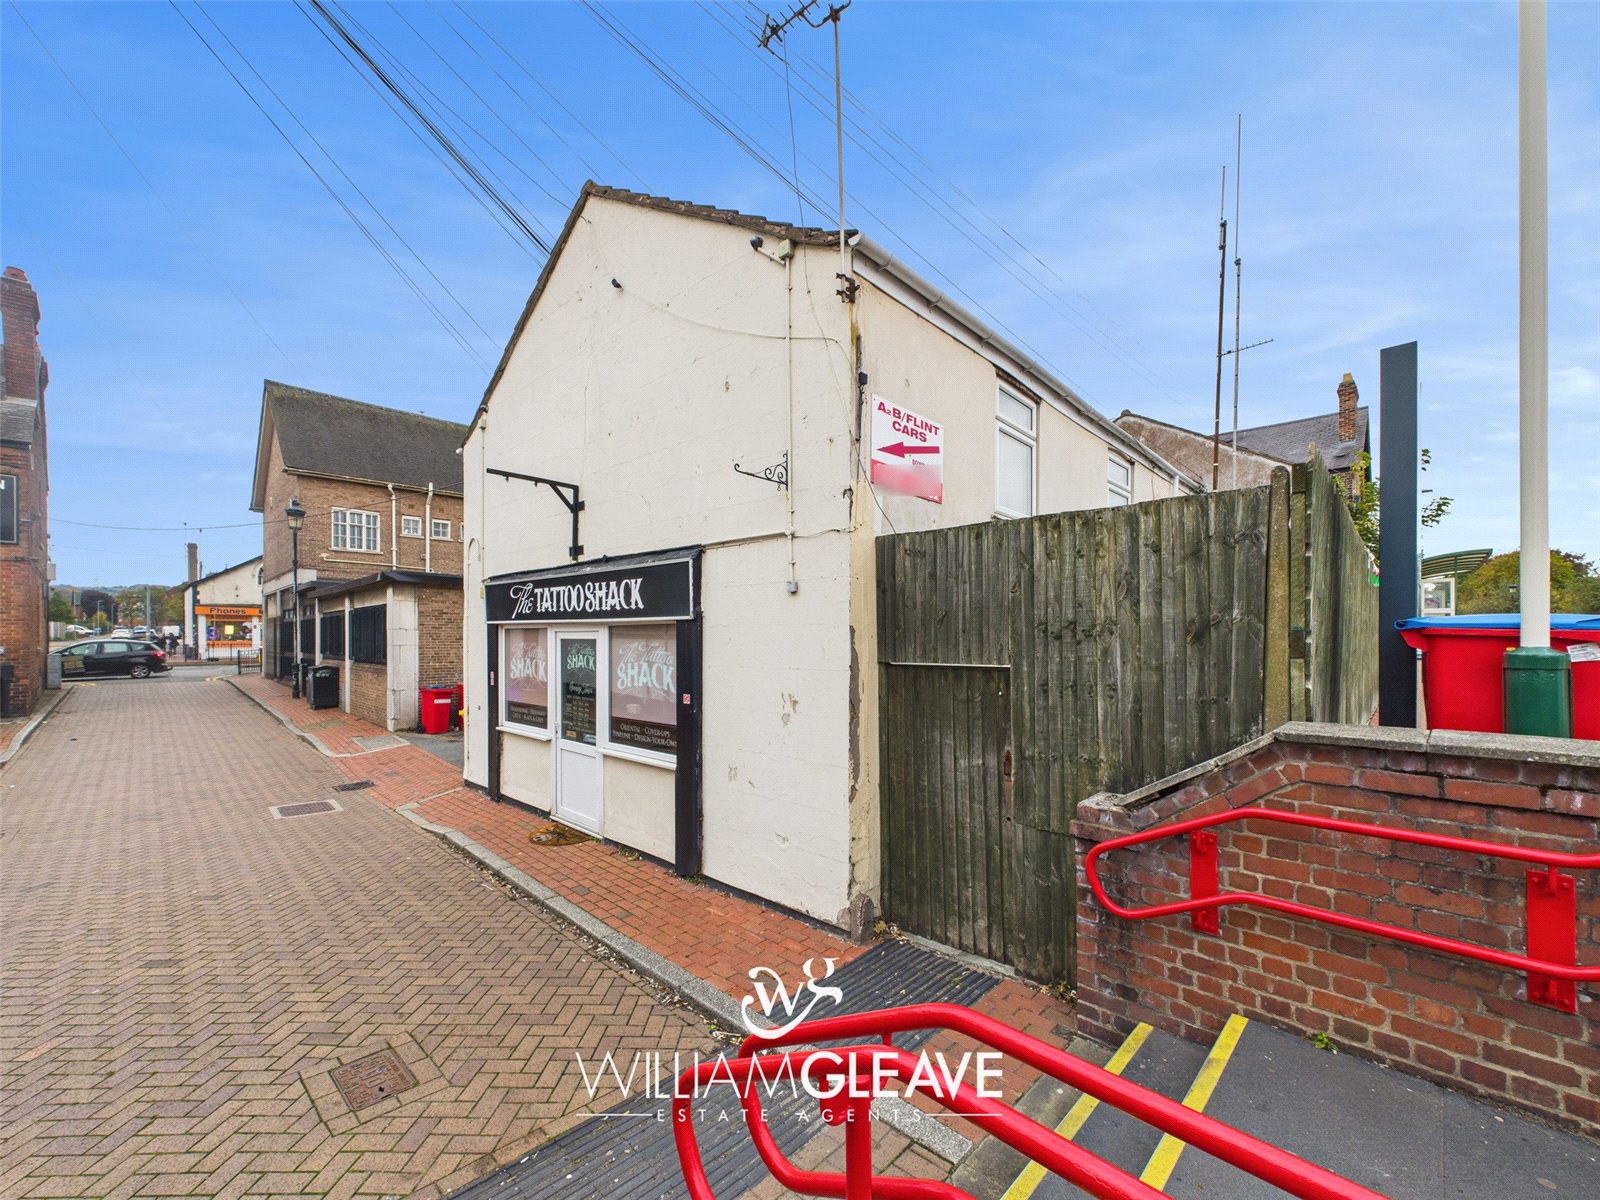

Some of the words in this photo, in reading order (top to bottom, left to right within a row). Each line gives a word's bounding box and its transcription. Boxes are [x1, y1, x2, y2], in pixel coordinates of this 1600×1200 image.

[892, 420, 927, 442] CARS
[510, 582, 534, 619] The
[534, 584, 584, 613] TATTOO
[585, 578, 644, 613] SHACK
[511, 657, 547, 682] SHACK
[567, 654, 595, 671] SHACK
[617, 662, 676, 692] SHACK
